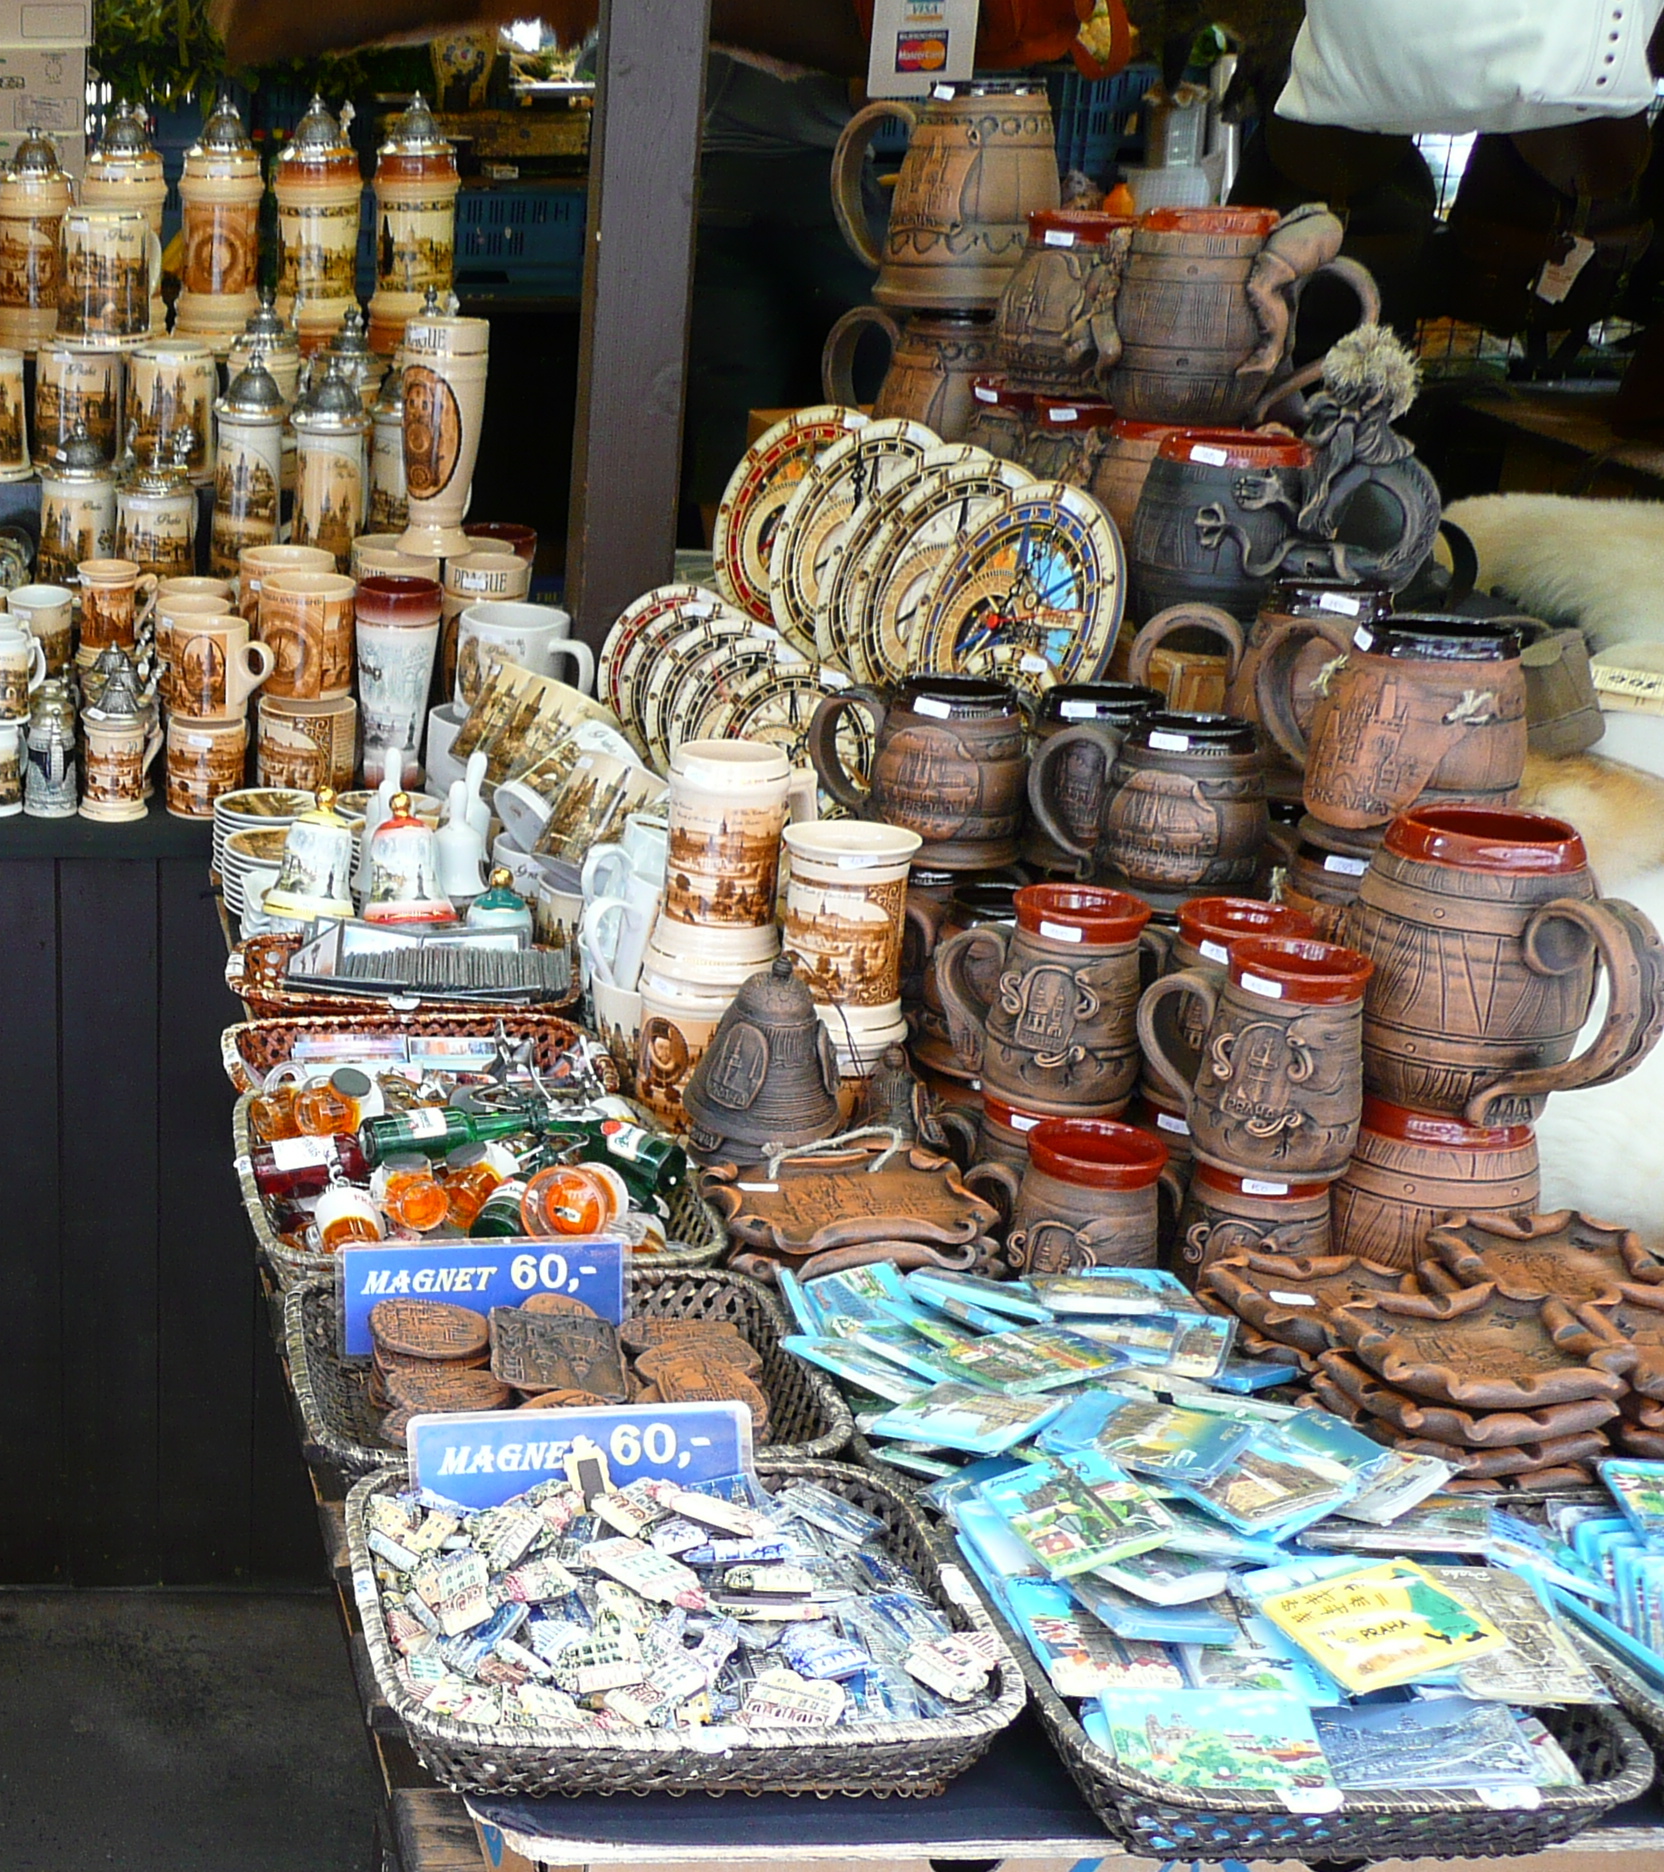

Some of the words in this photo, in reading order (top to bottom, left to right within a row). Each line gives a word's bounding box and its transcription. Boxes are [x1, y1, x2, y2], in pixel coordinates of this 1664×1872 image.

[360, 1266, 498, 1295] MAGNET
[510, 1253, 597, 1292] 60,-
[437, 1440, 574, 1476] MAGNE
[609, 1422, 711, 1470] 60,-
[1440, 1567, 1492, 1583] Praha
[1360, 1618, 1411, 1641] PRAHA
